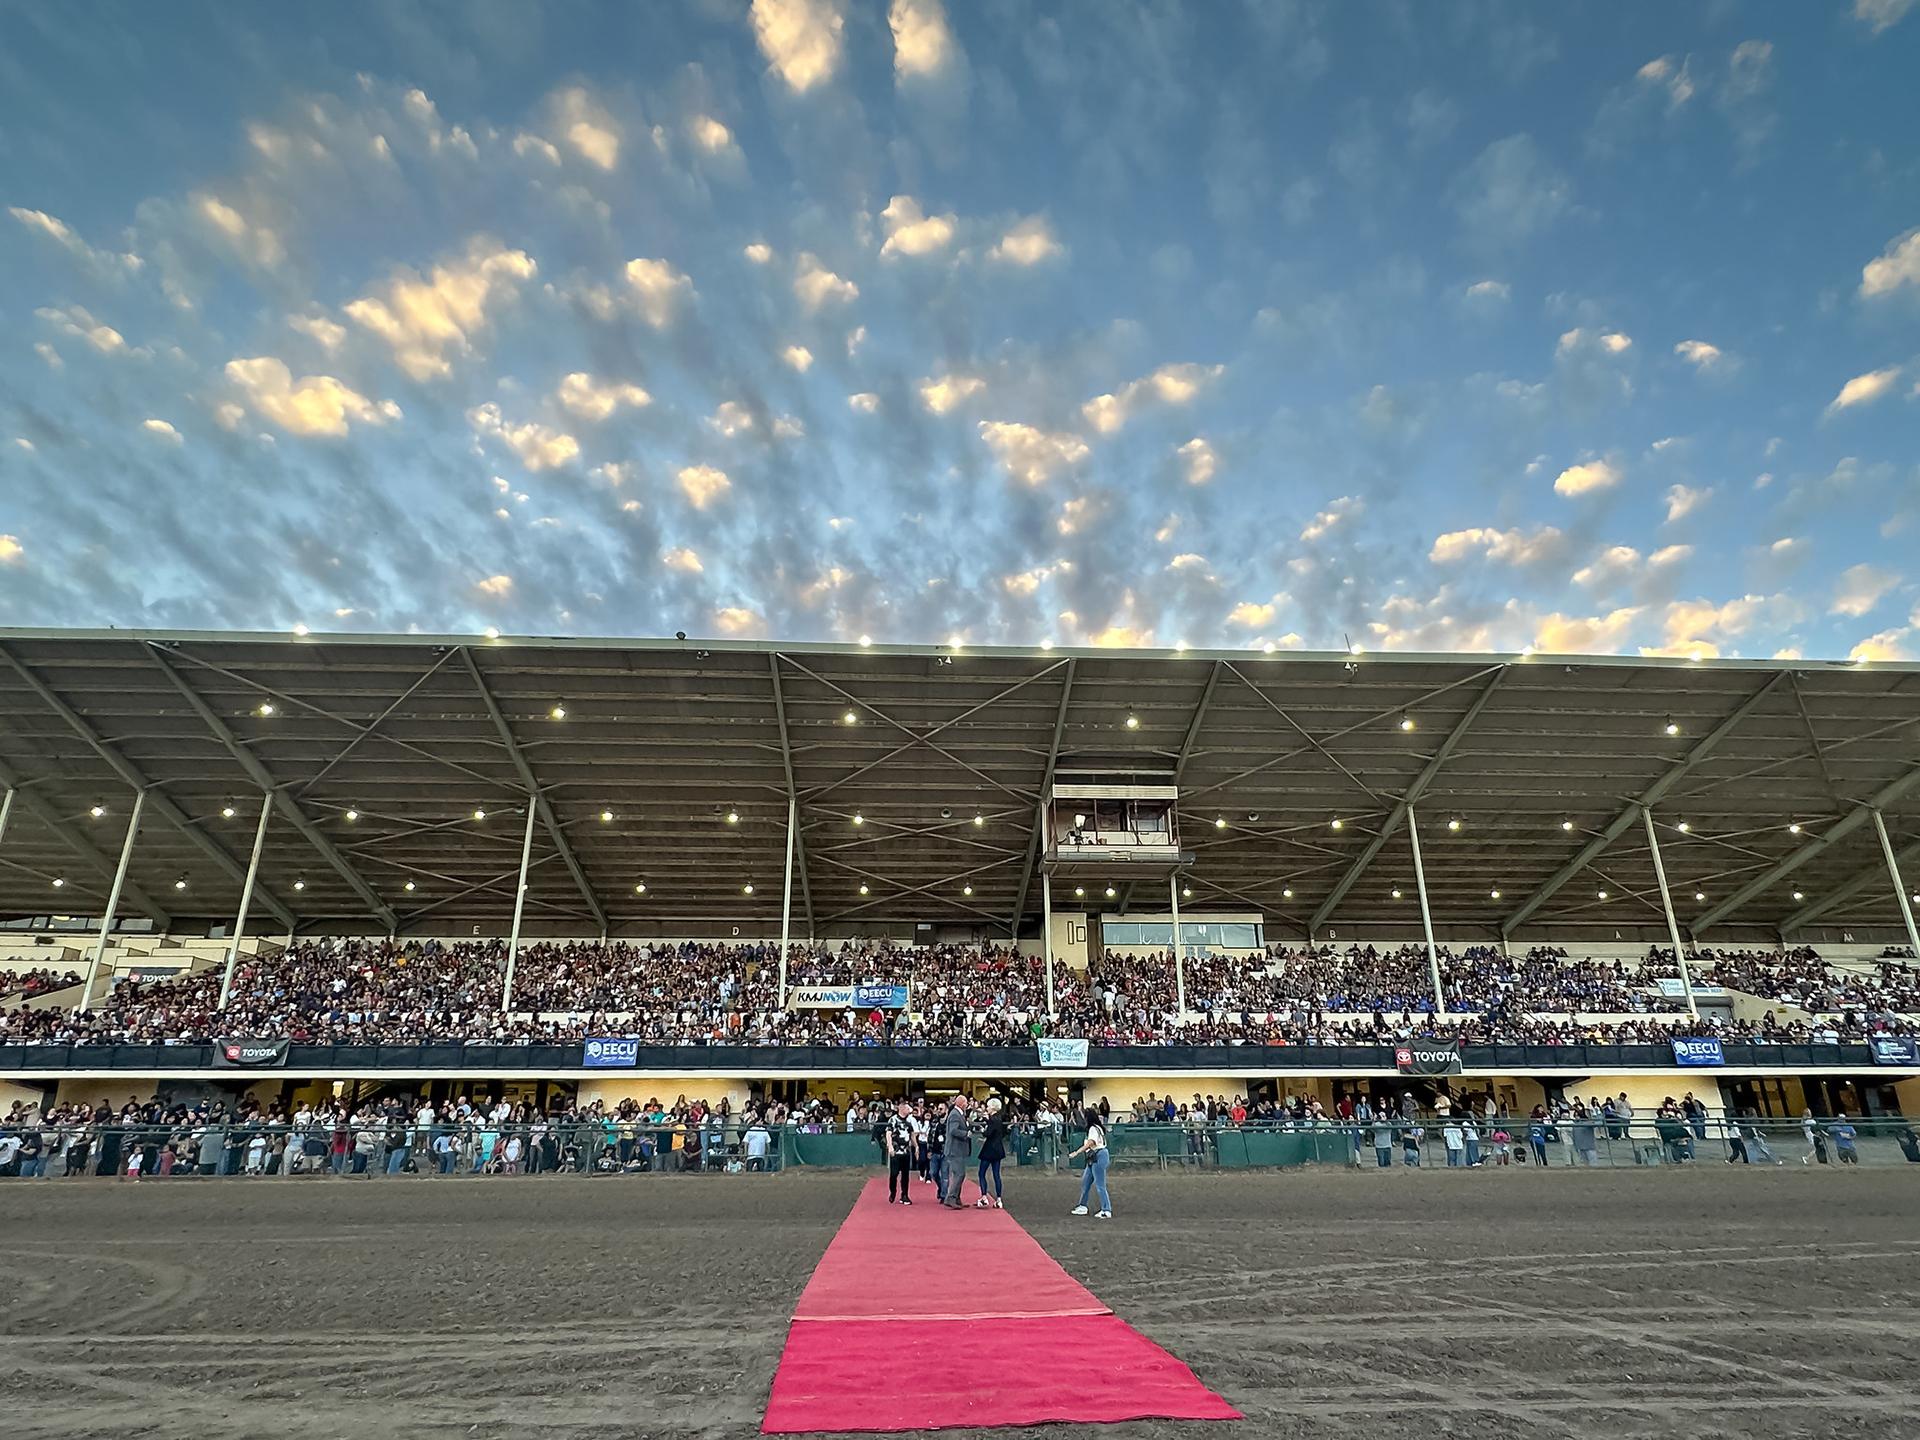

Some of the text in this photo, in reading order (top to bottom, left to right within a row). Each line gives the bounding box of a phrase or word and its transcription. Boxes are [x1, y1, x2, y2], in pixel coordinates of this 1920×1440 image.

[473, 925, 481, 935] E
[732, 926, 740, 936] D
[1329, 929, 1337, 939] B
[868, 988, 893, 998] EECU
[602, 1042, 637, 1055] EECU
[1053, 1042, 1074, 1051] Valley
[1687, 1042, 1719, 1054] EECU
[242, 1048, 277, 1057] TOYOTA
[1413, 1051, 1460, 1062] TOYOTA
